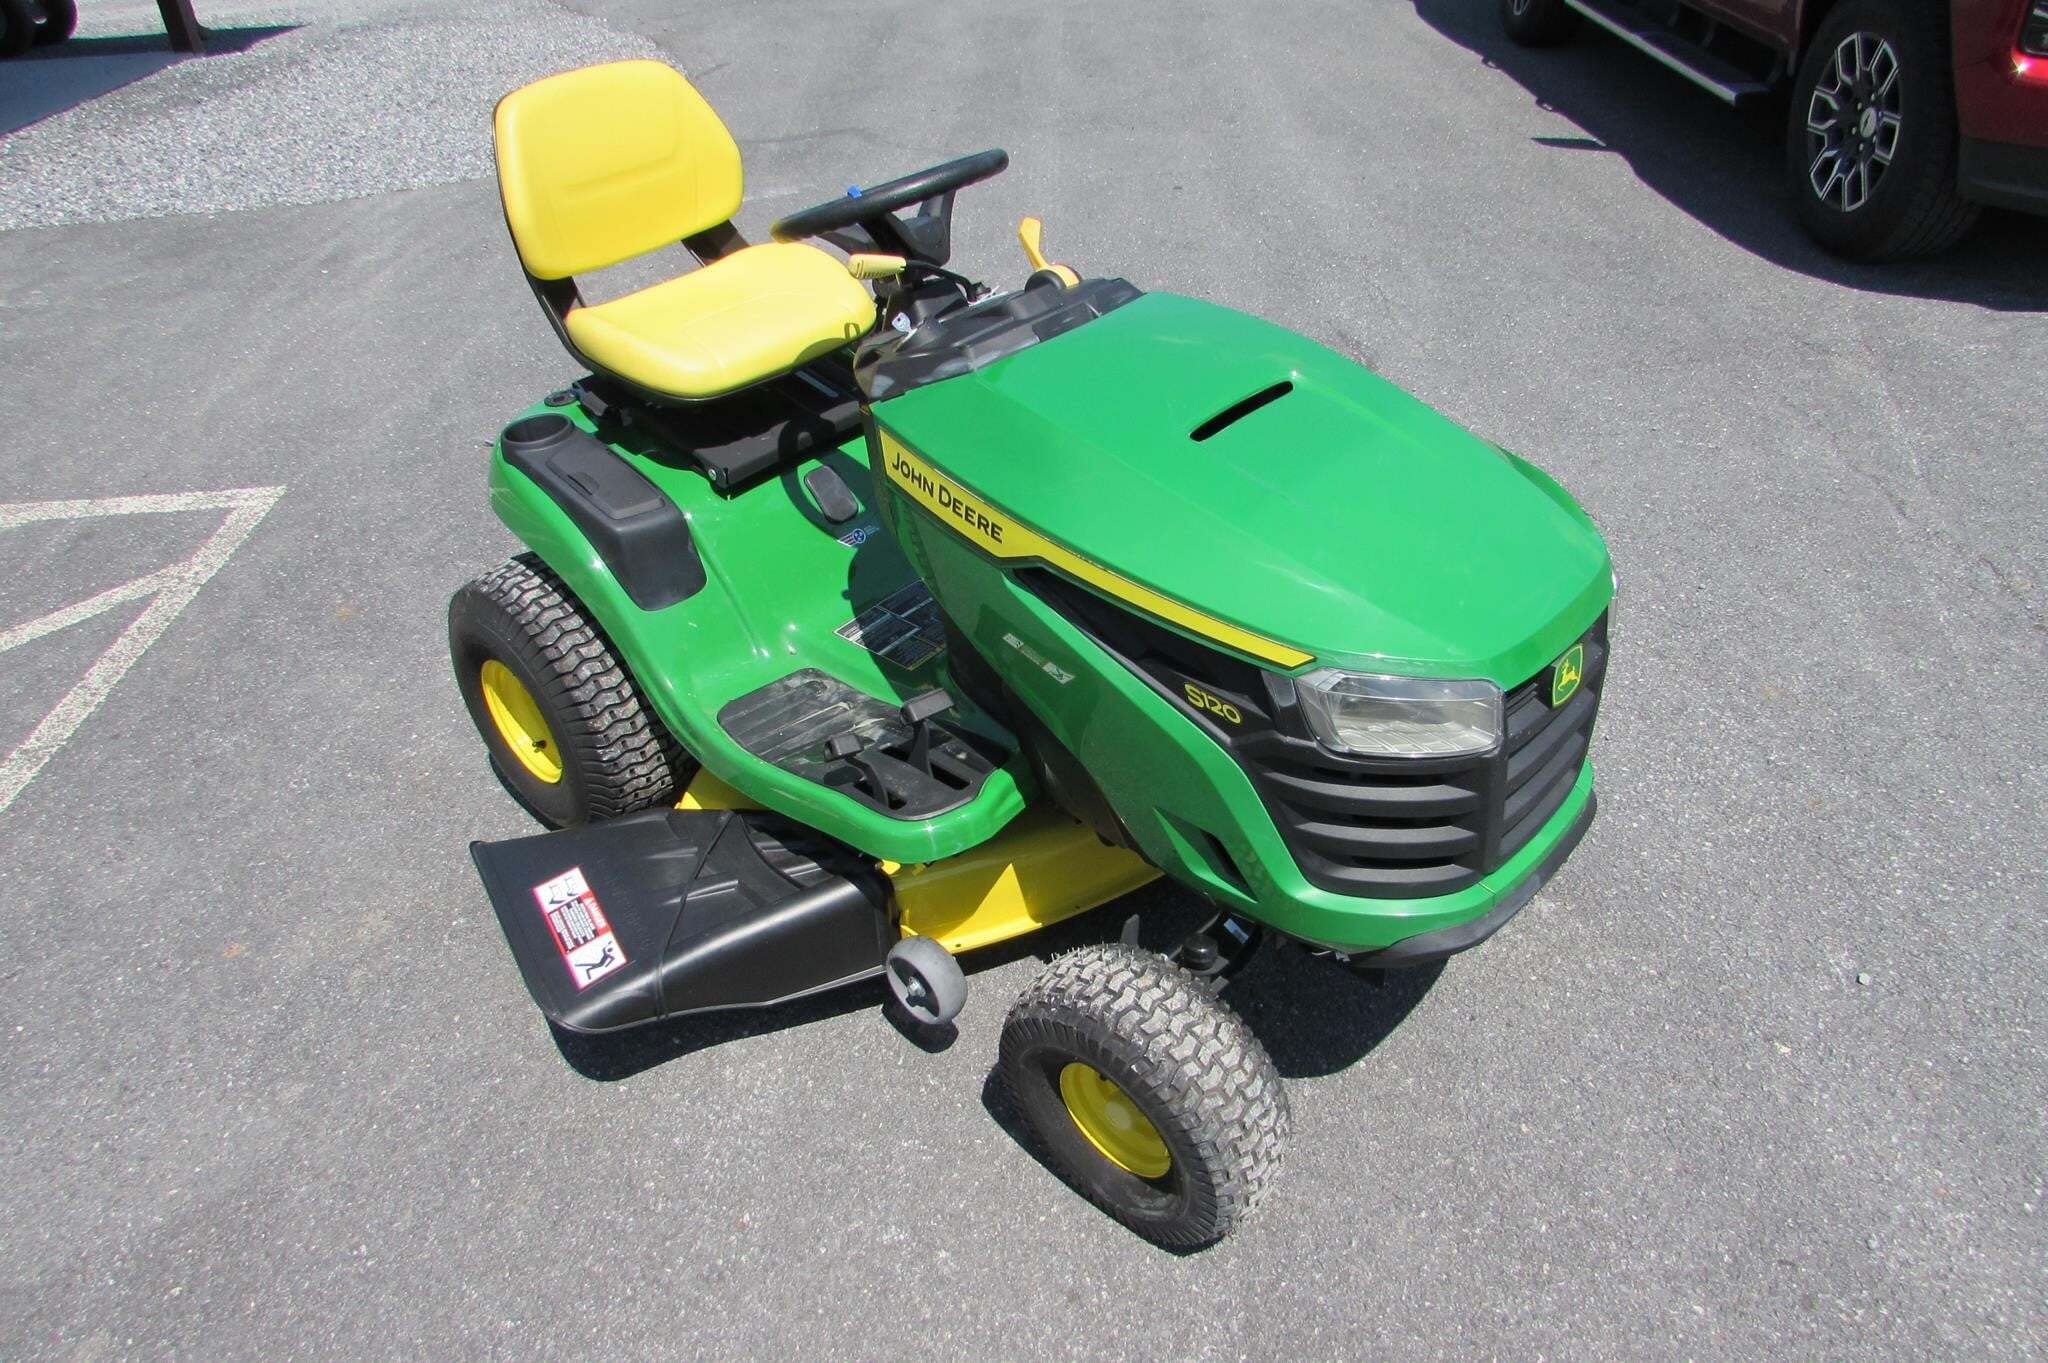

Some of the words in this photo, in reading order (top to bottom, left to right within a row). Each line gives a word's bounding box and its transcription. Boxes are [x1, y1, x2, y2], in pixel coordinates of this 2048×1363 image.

[892, 452, 935, 498] JOHN
[938, 484, 1003, 544] DEERE
[1184, 683, 1241, 724] S120
